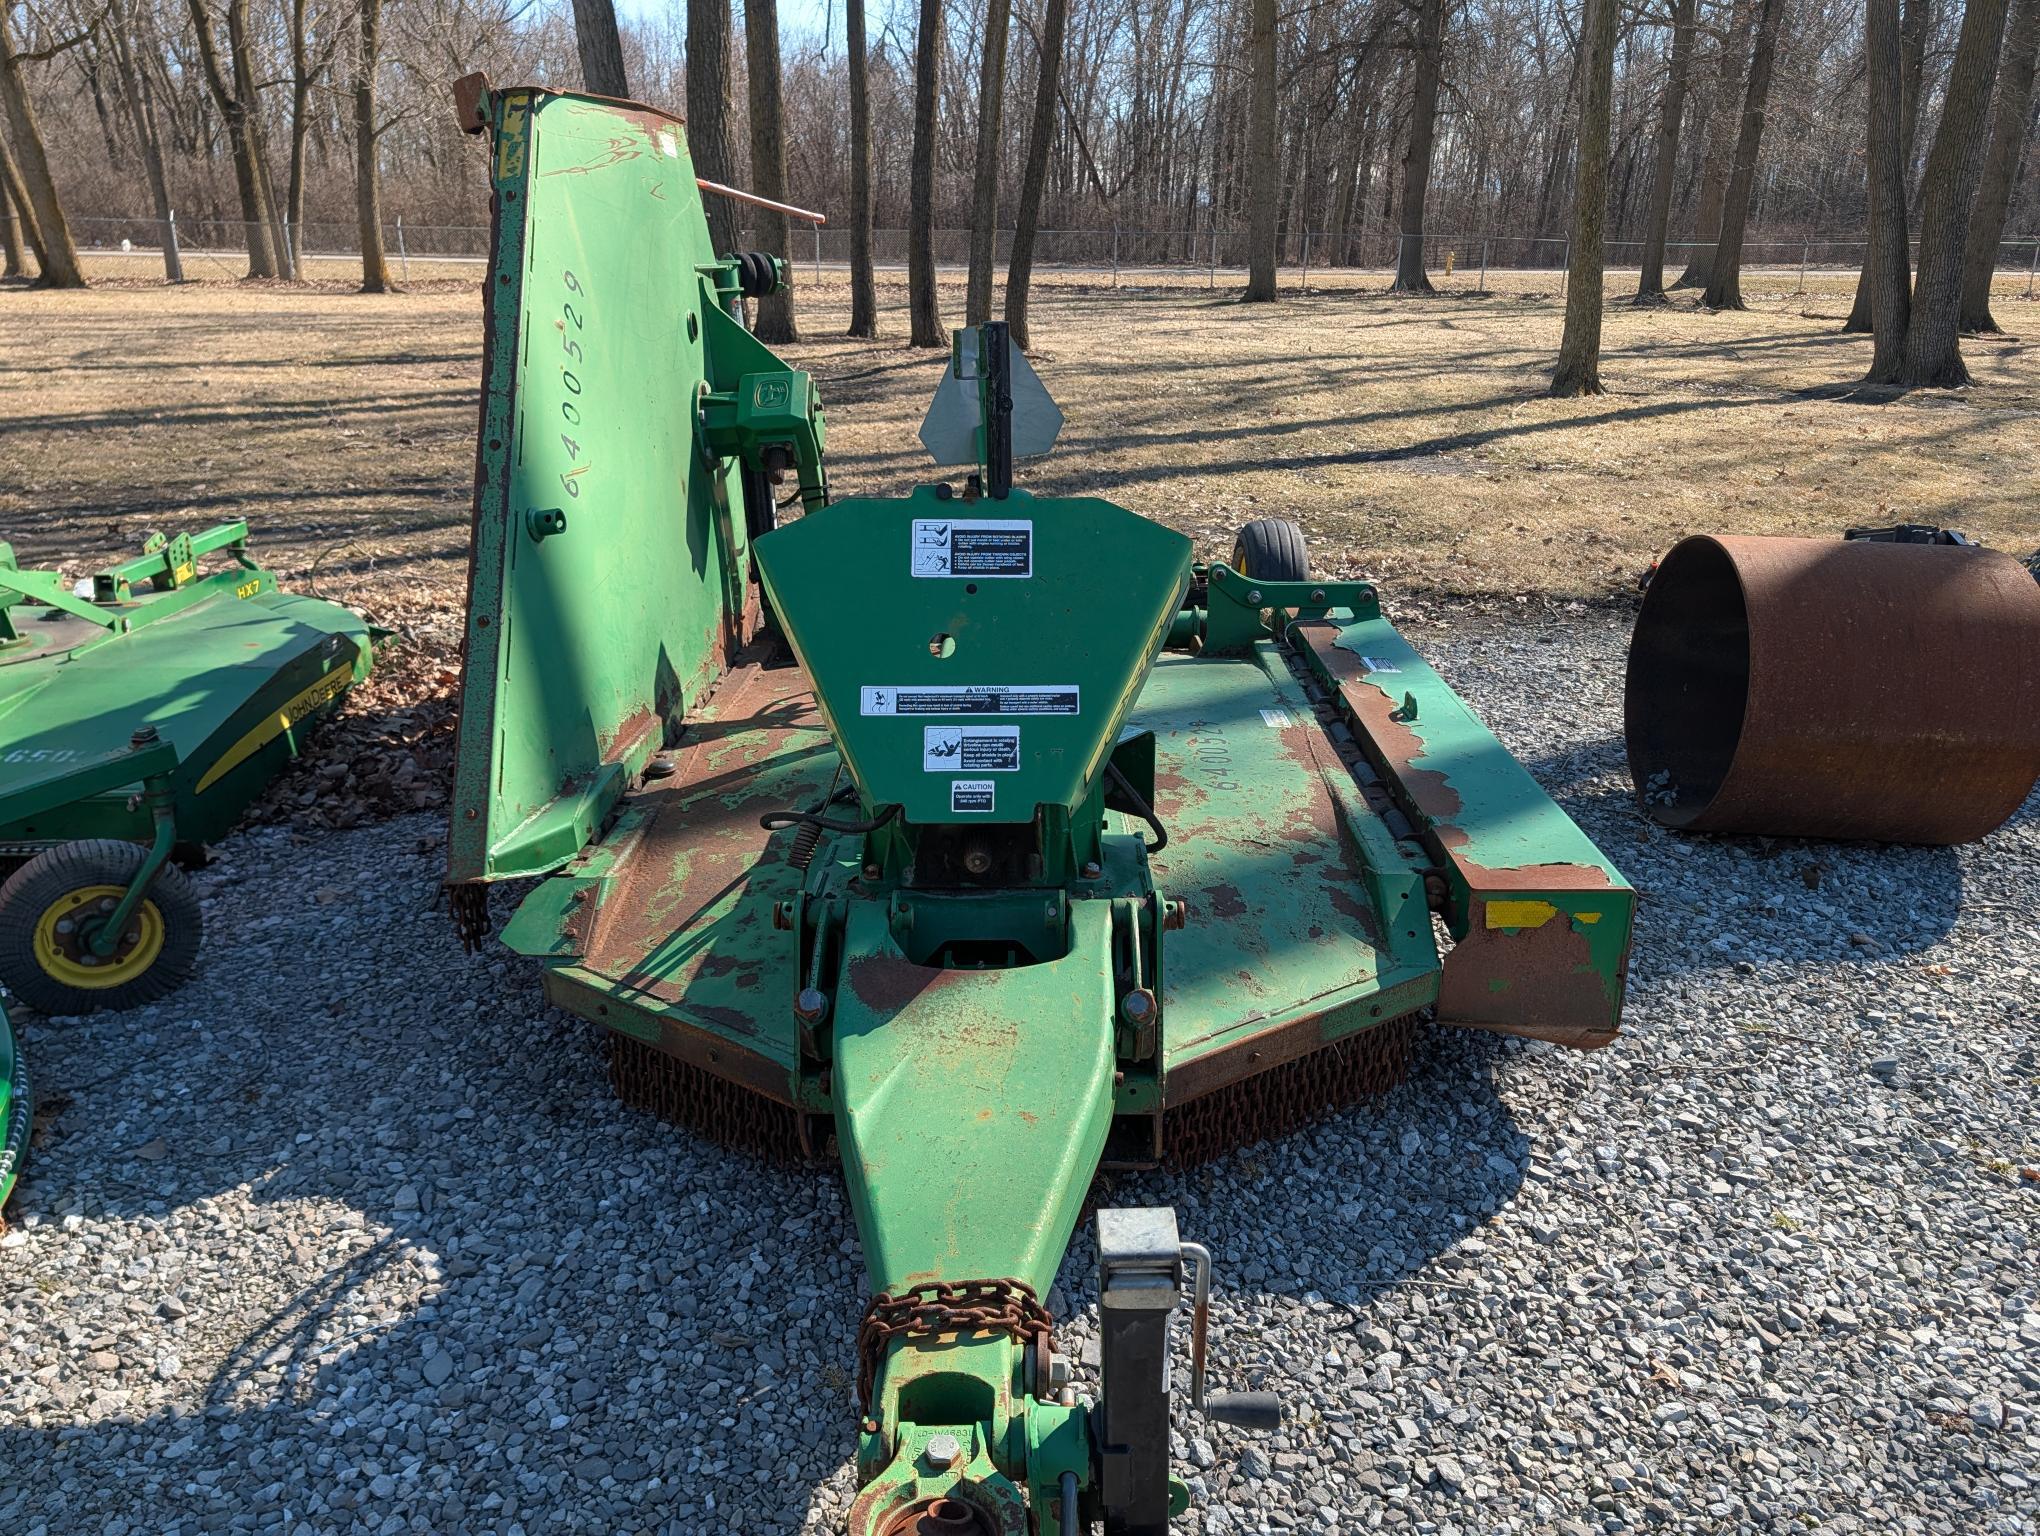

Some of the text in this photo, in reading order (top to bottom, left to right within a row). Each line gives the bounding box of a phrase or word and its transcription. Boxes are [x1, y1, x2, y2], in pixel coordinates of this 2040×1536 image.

[560, 270, 585, 498] 6400529
[237, 580, 260, 600] HX7
[1188, 720, 1238, 790] 6400529
